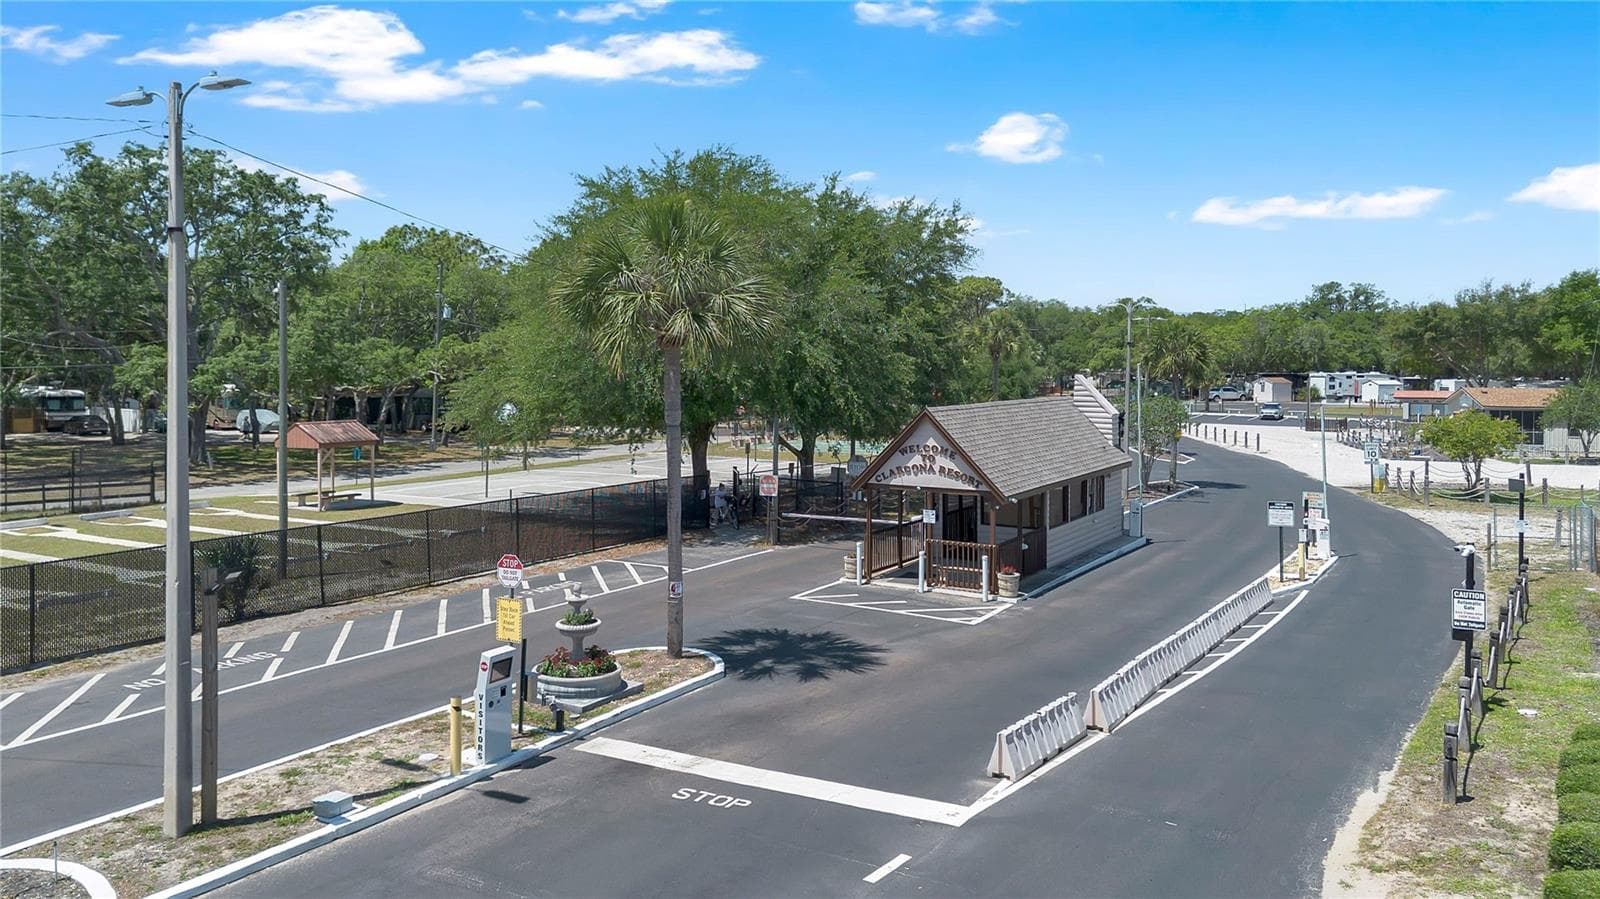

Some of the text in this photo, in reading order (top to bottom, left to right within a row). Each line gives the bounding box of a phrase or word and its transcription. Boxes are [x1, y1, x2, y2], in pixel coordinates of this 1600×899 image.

[898, 444, 956, 460] WELCOME
[920, 453, 936, 465] TO
[938, 465, 983, 489] RESORT
[502, 559, 518, 568] STOP
[1454, 591, 1484, 599] CAUTION
[671, 787, 752, 809] STOP
